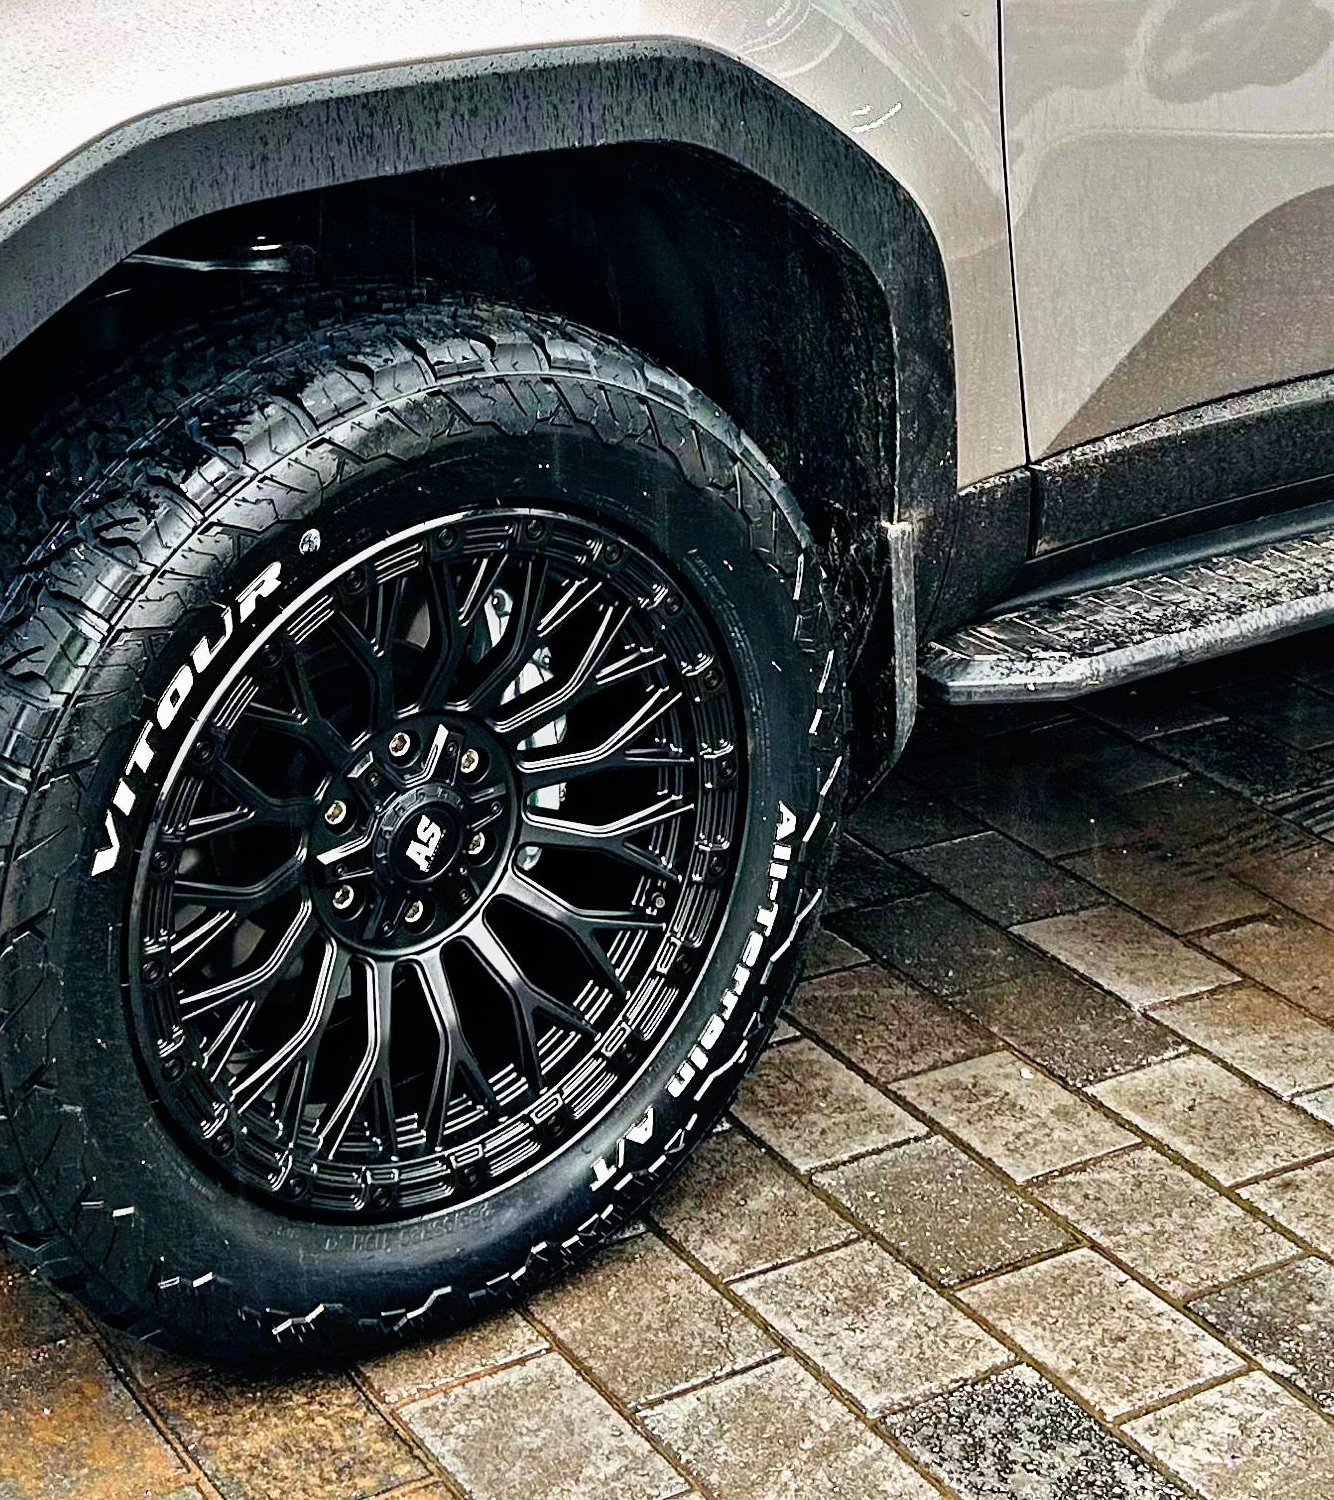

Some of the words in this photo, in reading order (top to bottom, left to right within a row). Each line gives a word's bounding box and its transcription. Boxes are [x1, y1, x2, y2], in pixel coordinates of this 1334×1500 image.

[90, 561, 282, 877] VITOUR
[405, 814, 442, 873] AS
[589, 1105, 654, 1192] A/T
